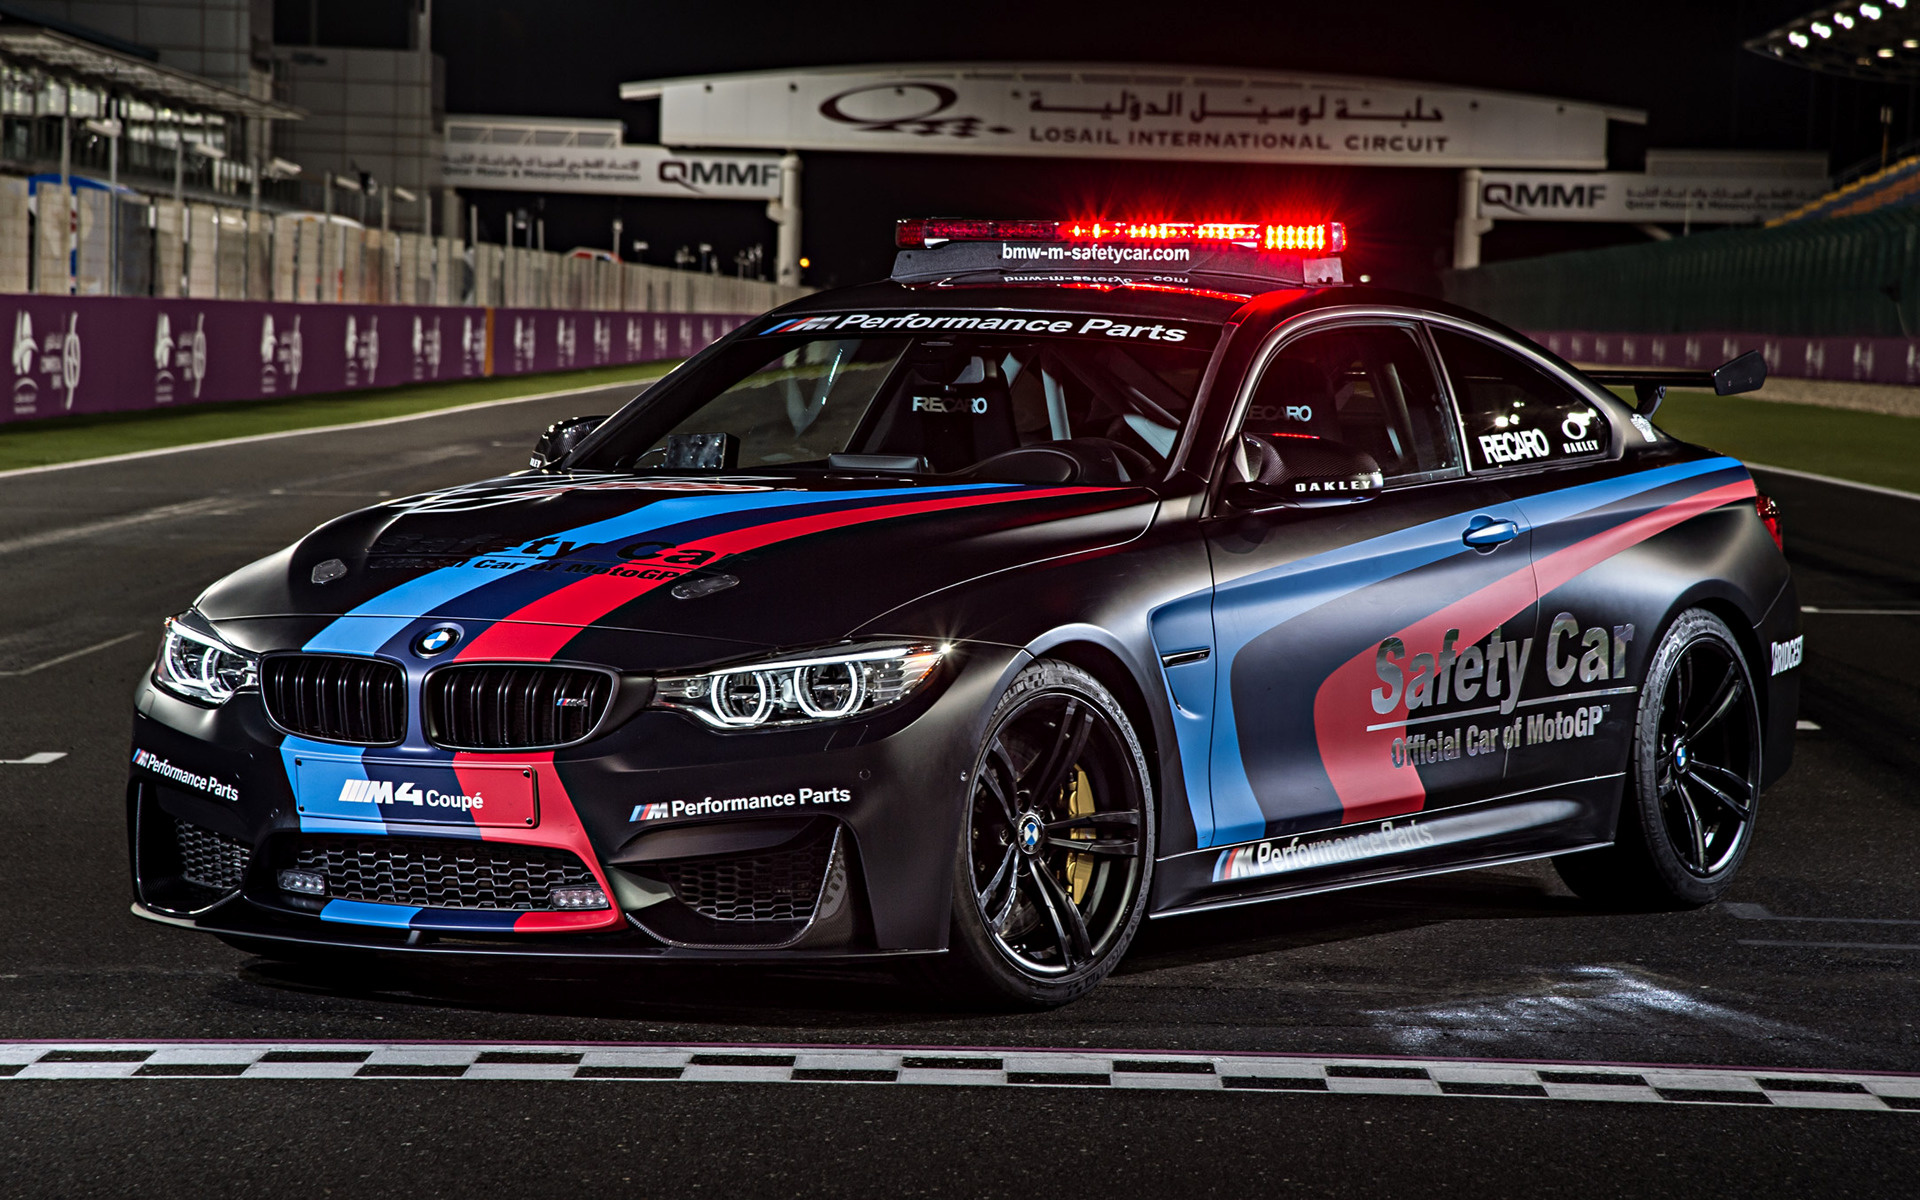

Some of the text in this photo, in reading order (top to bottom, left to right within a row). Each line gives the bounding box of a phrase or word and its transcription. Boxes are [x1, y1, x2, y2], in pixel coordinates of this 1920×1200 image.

[1029, 127, 1448, 152] LOSAIL INTERNATIONAL CIRCUIT
[658, 160, 780, 194] QMMF
[1483, 183, 1606, 215] QMMF
[1002, 243, 1190, 264] bmw-m-safetycar.com
[834, 313, 1073, 333] Performance
[1078, 318, 1188, 342] Parts
[1246, 405, 1312, 422] ECARO
[1478, 428, 1549, 464] RECARO
[1562, 439, 1599, 454] OAKLEY
[1295, 480, 1371, 492] OAKLEY
[473, 559, 525, 570] Car
[1371, 611, 1635, 715] Safety Car
[1391, 728, 1460, 769] Official
[1466, 724, 1499, 757] Car
[1502, 716, 1522, 750] of
[147, 753, 207, 790] Performance
[207, 776, 239, 801] Parts
[426, 792, 483, 811] Coupé
[671, 797, 796, 817] Performance
[799, 787, 851, 805] Parts
[1257, 837, 1379, 873] Performance
[1381, 820, 1434, 850] Parts
